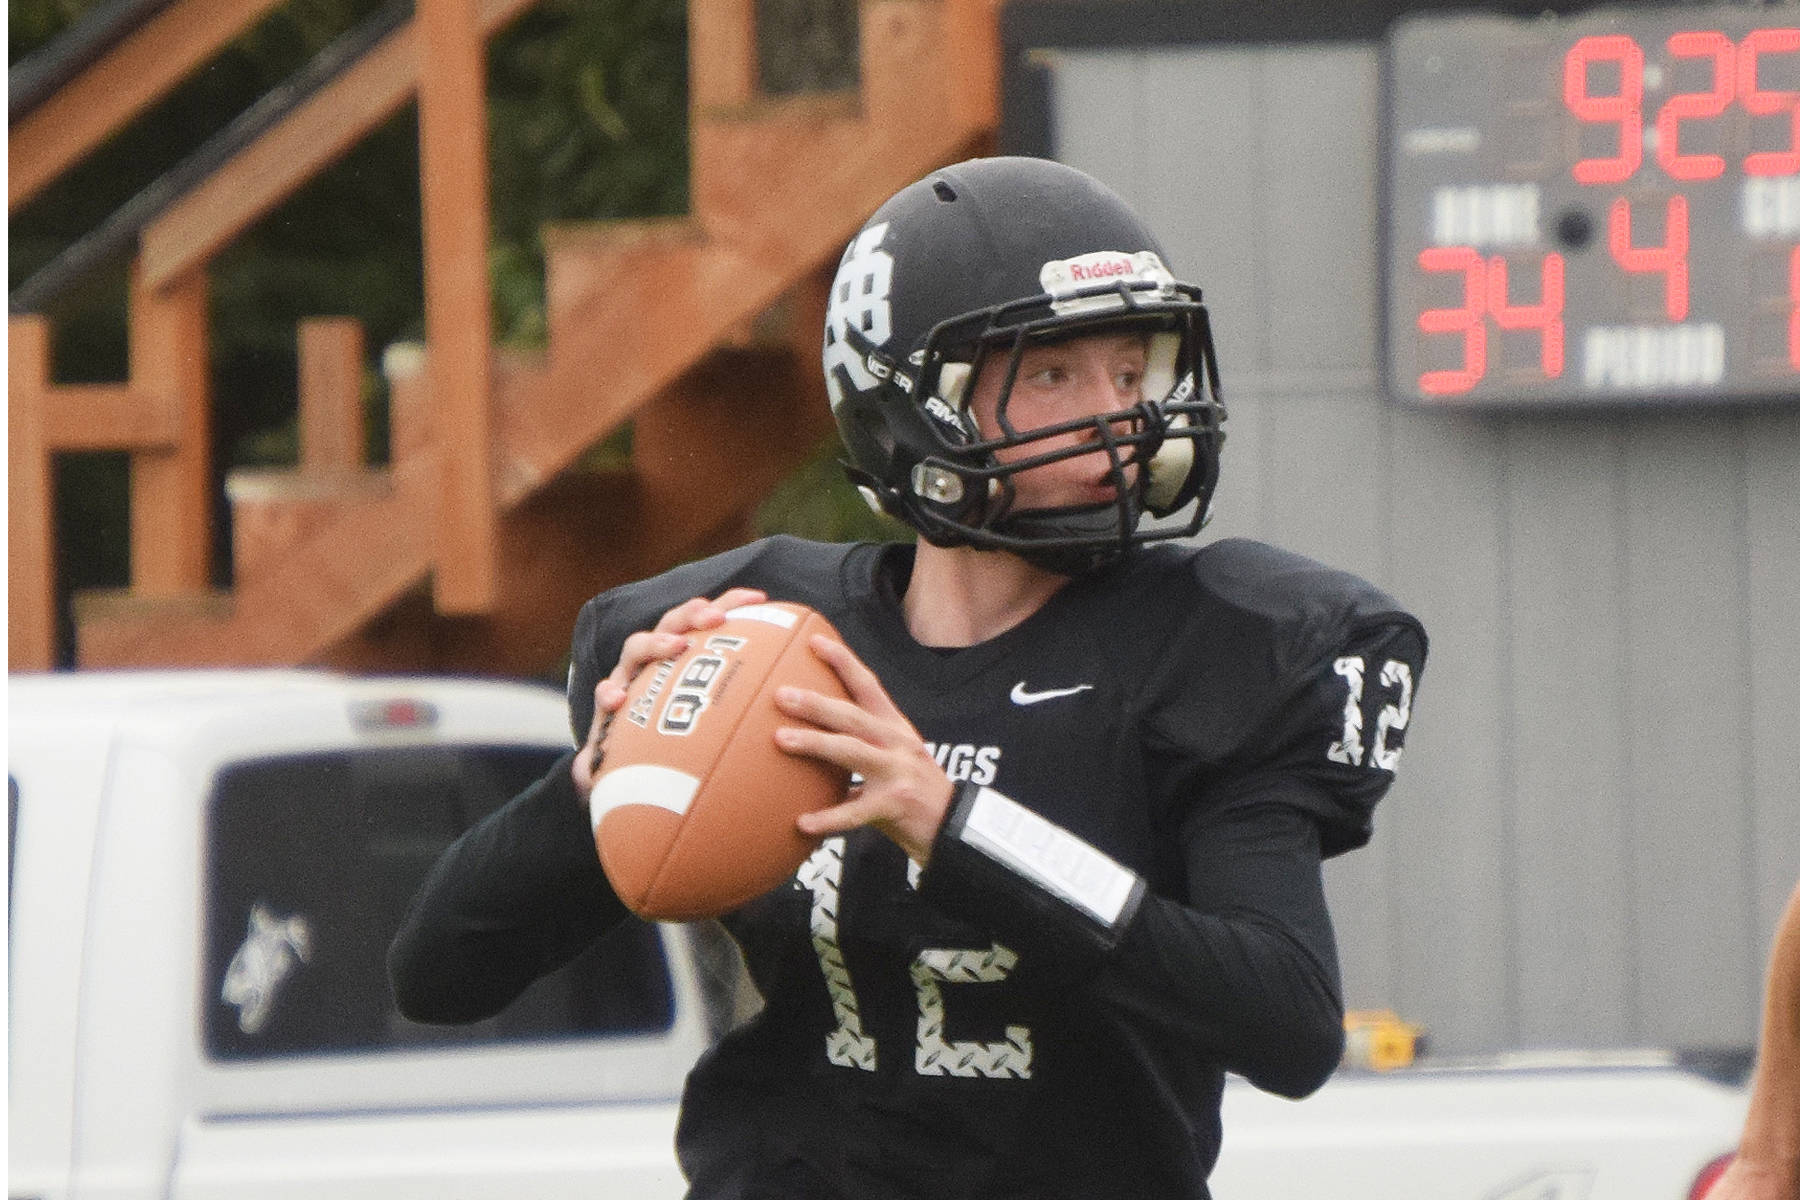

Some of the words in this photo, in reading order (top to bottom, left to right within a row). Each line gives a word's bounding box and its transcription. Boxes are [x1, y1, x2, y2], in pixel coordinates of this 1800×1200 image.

[1069, 259, 1134, 282] Riddell
[1608, 193, 1689, 322] 4
[1417, 245, 1565, 395] 34
[656, 636, 749, 736] QB1
[1326, 655, 1413, 771] 12
